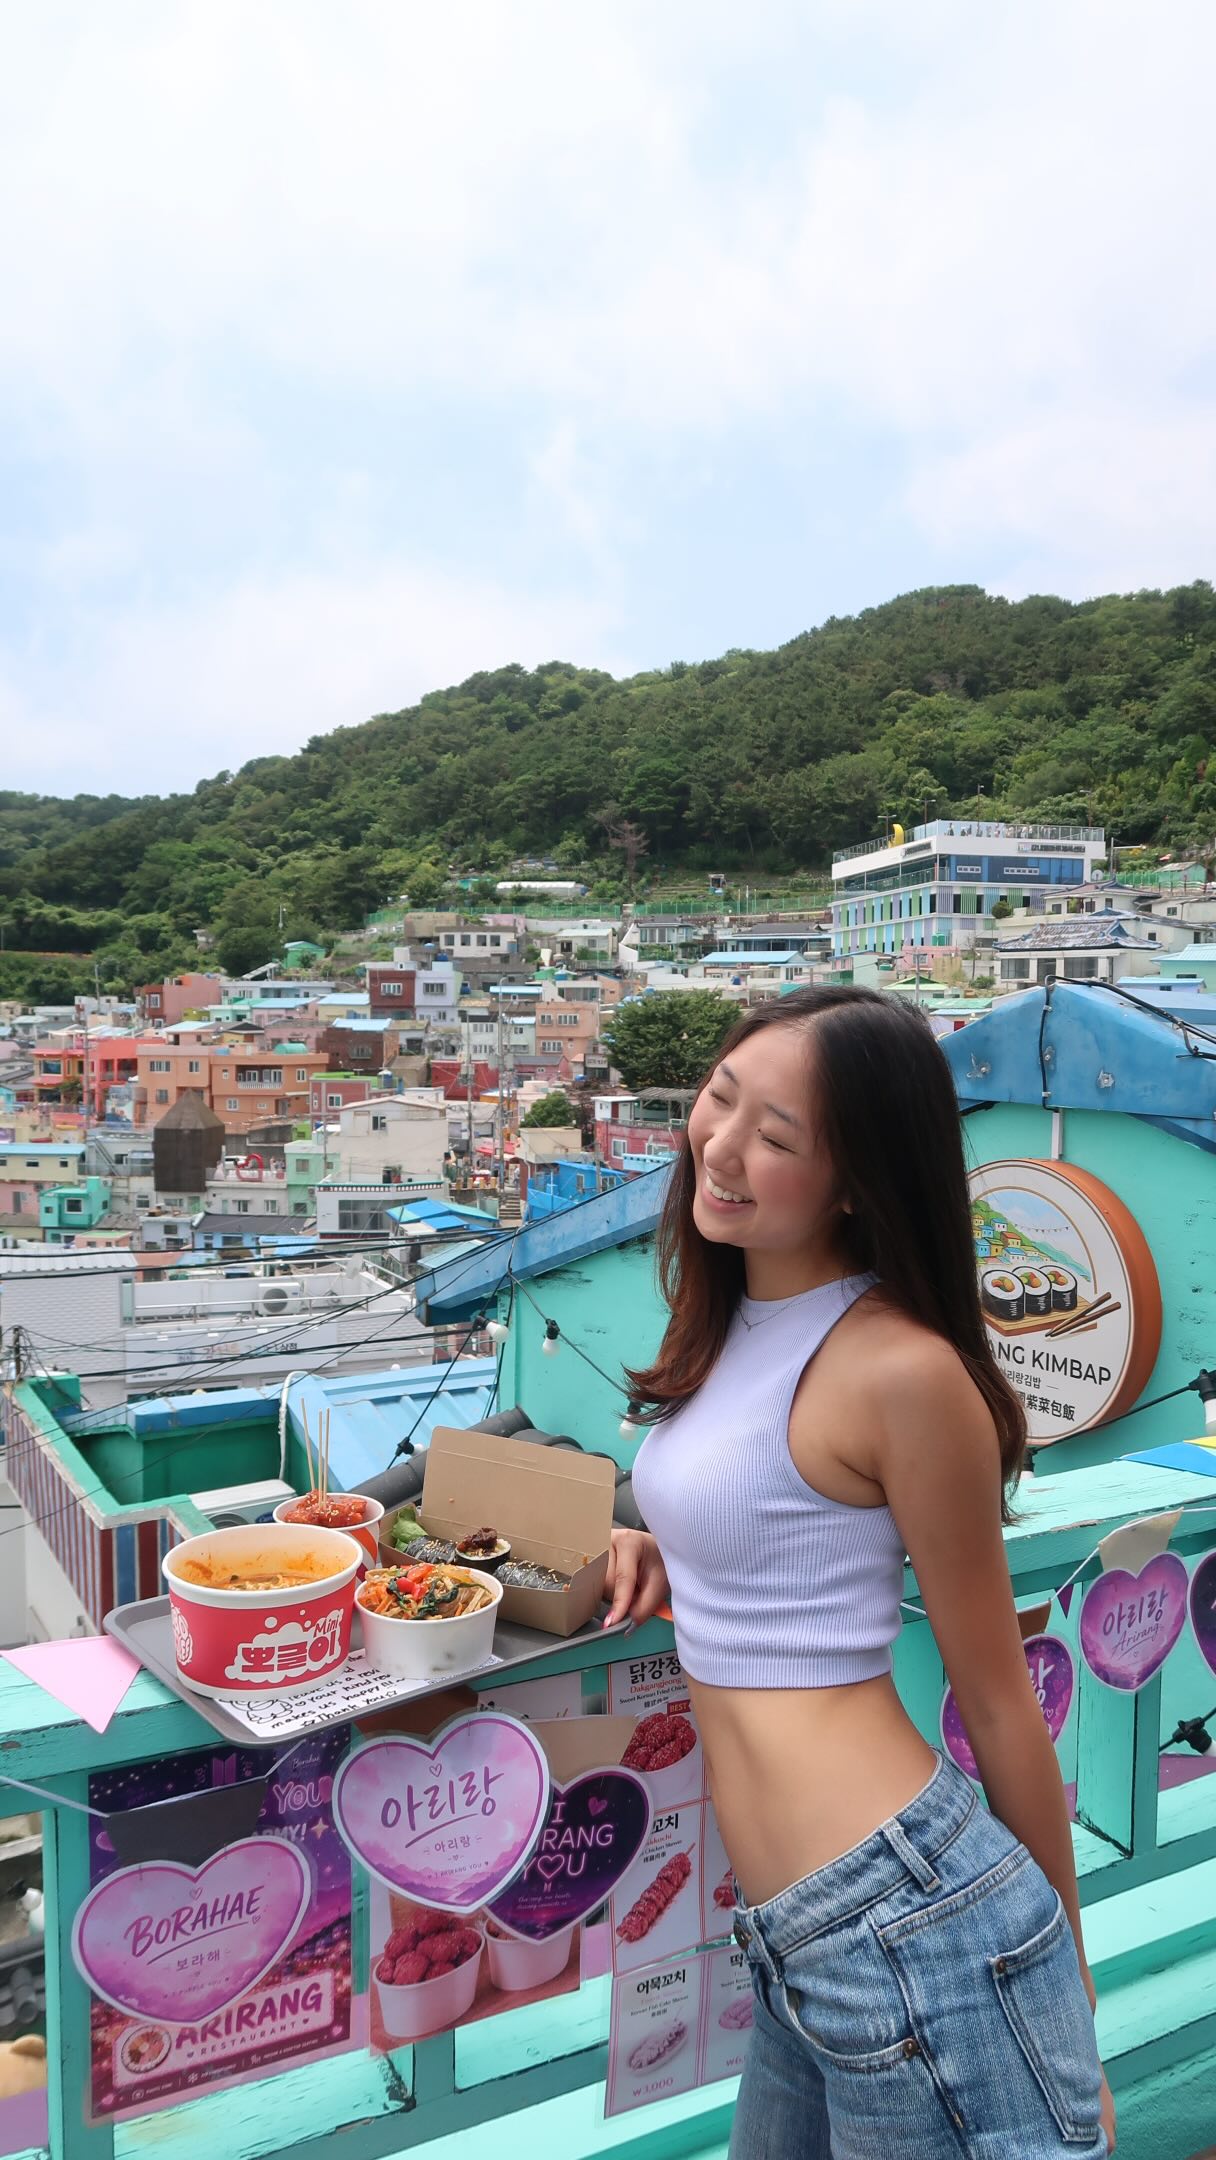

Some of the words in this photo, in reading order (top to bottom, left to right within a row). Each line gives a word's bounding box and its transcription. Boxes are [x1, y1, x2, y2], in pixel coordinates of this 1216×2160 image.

[1031, 1349, 1112, 1386] KIMBAP
[1102, 1583, 1169, 1637] 아리랑
[313, 1615, 340, 1638] Mini
[1111, 1623, 1160, 1657] Arirang
[241, 1630, 337, 1673] 뽀글이
[629, 1655, 681, 1685] 닭강정
[630, 1678, 682, 1694] Dakgangjeong
[671, 1684, 688, 1693] Chicke
[271, 1708, 314, 1729] makes
[323, 1700, 337, 1710] us
[318, 1703, 361, 1723] Thank
[671, 1702, 688, 1713] BEST
[381, 1766, 505, 1832] 아리랑
[434, 1835, 471, 1853] 아리랑
[176, 1948, 221, 1972] 보라해
[636, 1969, 686, 1994] 어묵꼬치
[175, 1982, 323, 2050] ARIRANG
[200, 2021, 297, 2056] RESTAURANT
